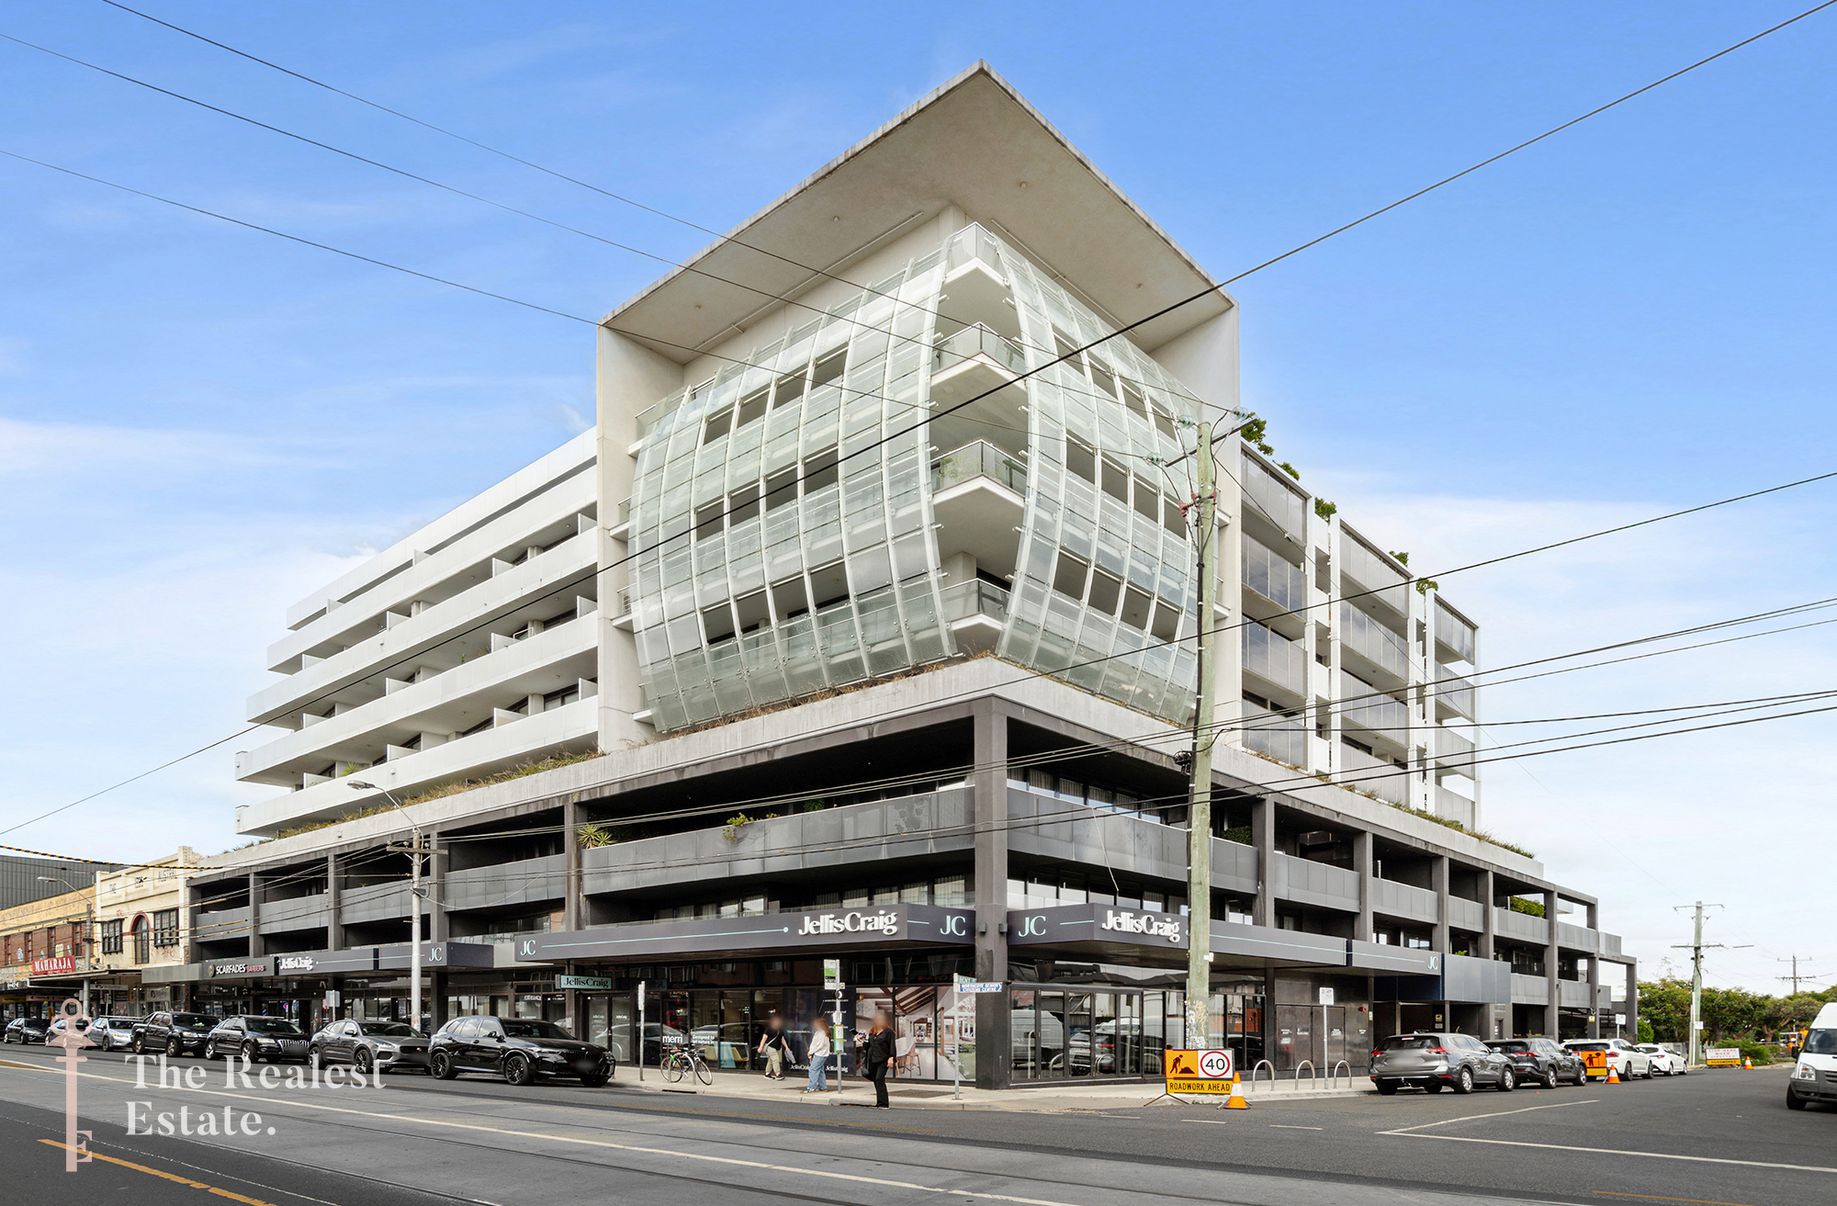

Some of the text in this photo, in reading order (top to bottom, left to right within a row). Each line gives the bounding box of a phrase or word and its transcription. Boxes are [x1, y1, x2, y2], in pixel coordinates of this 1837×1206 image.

[940, 915, 966, 936] JC
[1018, 915, 1047, 937] JC
[428, 946, 442, 961] JC
[520, 939, 536, 956] JC
[34, 957, 72, 972] MAHARAJA
[215, 963, 246, 975] SCARFADES
[1427, 955, 1438, 970] JC
[662, 1033, 683, 1043] merri
[1205, 1058, 1225, 1070] 40
[1169, 1082, 1231, 1091] ROADWORK AHEAD
